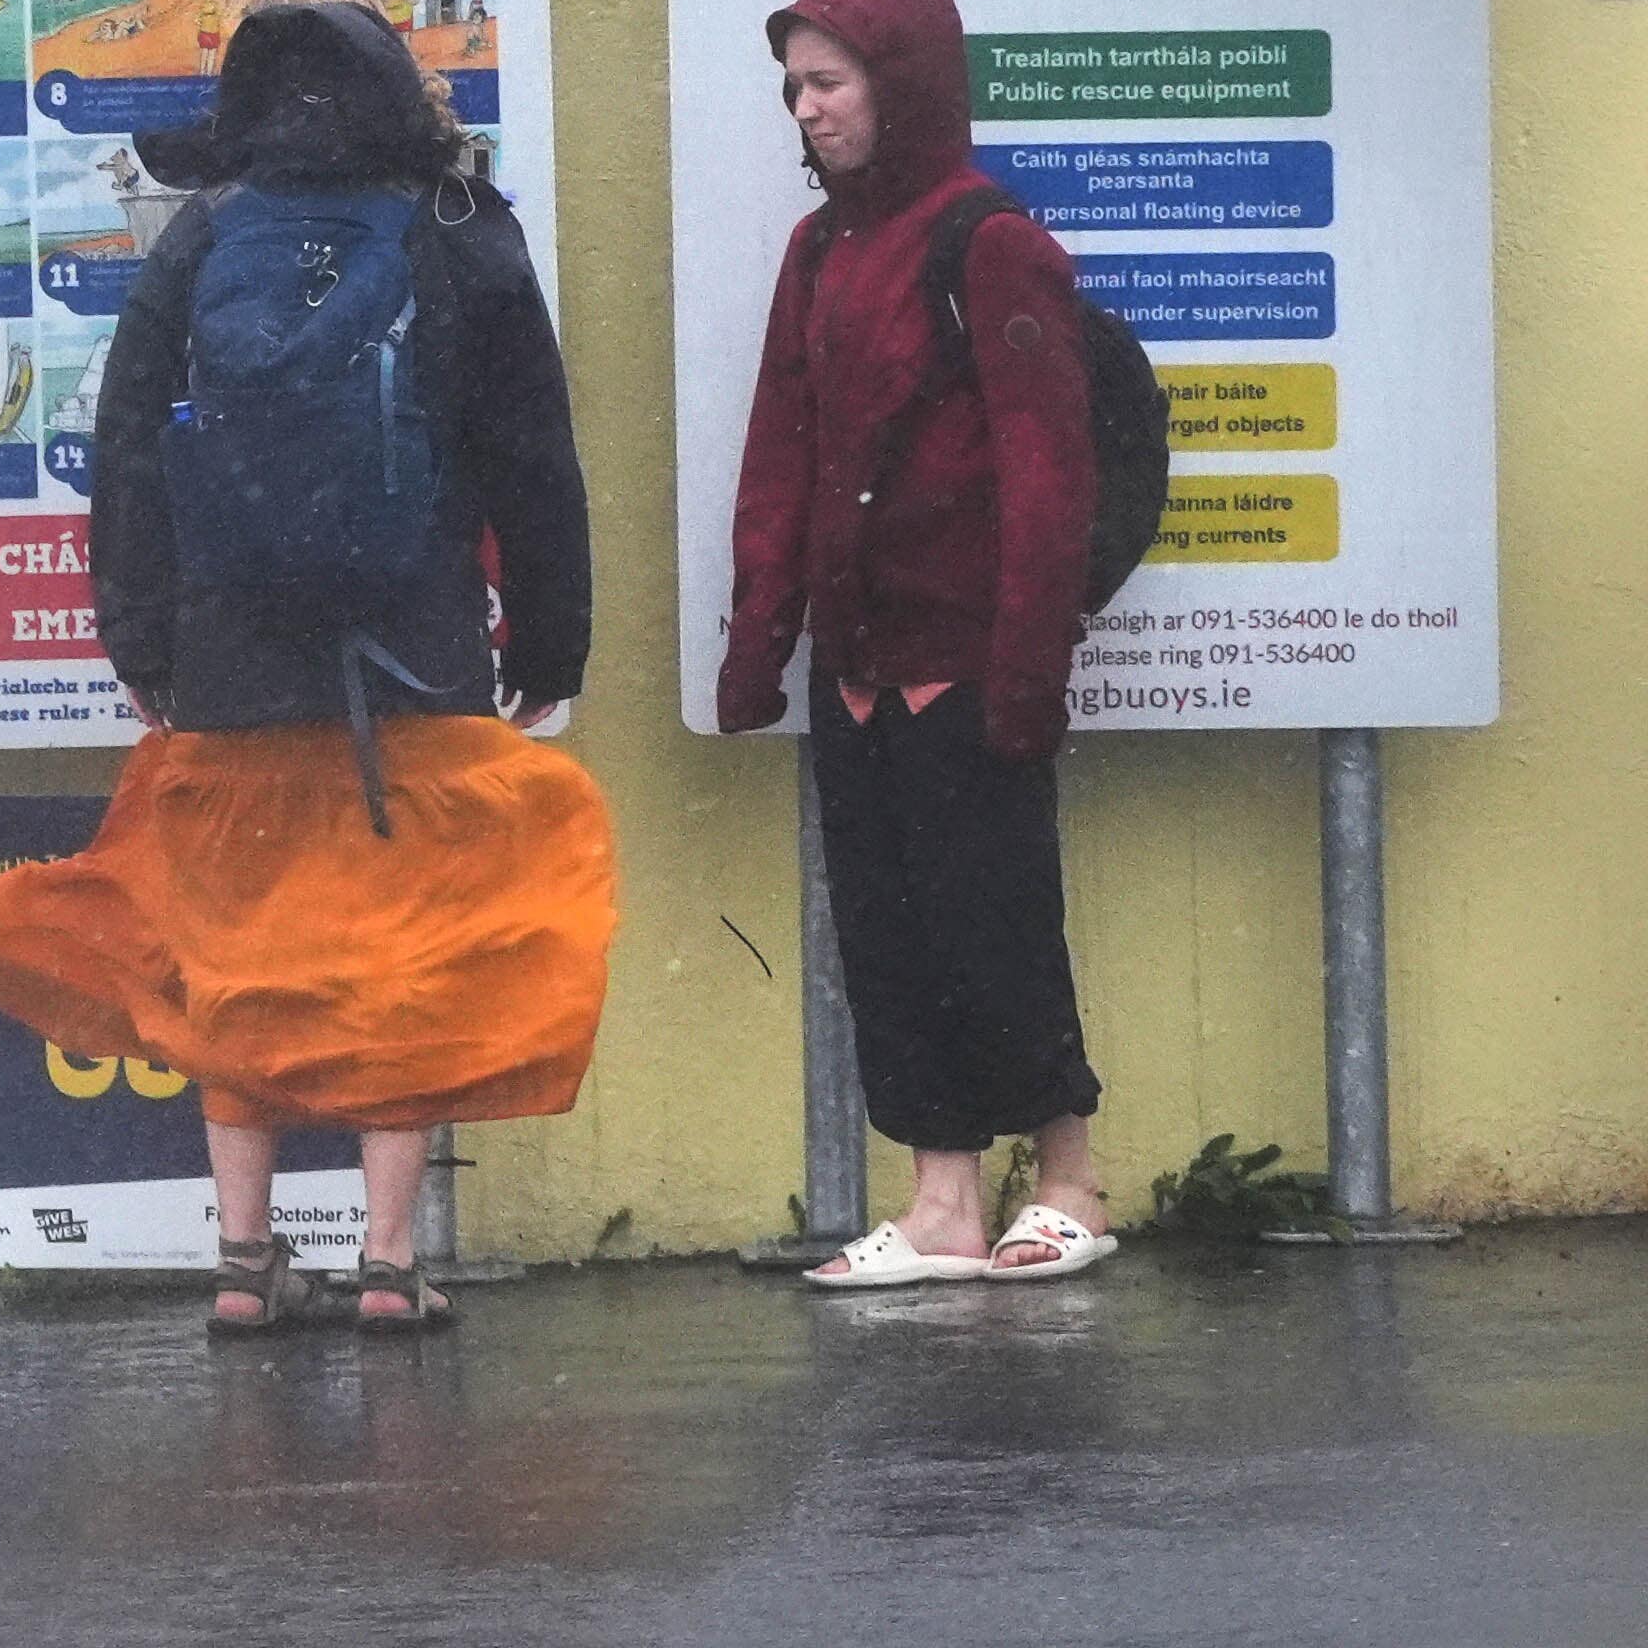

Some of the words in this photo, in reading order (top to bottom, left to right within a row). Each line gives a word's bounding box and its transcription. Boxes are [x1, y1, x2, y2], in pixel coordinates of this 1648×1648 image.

[991, 48, 1102, 67] Trealamh
[1109, 47, 1211, 66] tarrthála
[51, 83, 67, 105] 8
[989, 82, 1064, 101] Public
[1072, 85, 1154, 100] rescue
[1161, 80, 1290, 102] equipment
[1012, 151, 1067, 167] Caith
[1074, 150, 1131, 171] gléas
[1138, 150, 1269, 166] snámhachta
[1088, 174, 1193, 192] pearsanta
[1044, 203, 1137, 223] personal
[1144, 203, 1224, 223] floating
[1232, 202, 1301, 218] device
[50, 264, 79, 287] 11
[1132, 271, 1172, 287] faoi
[1180, 270, 1326, 286] mhaoirseacht
[1123, 304, 1186, 323] under
[1192, 303, 1318, 322] supervision
[1216, 384, 1267, 399] báite
[1227, 415, 1305, 436] objects
[54, 446, 85, 468] 14
[1234, 494, 1293, 511] láidre
[1197, 527, 1287, 545] currents
[1164, 616, 1185, 630] ar
[1192, 609, 1336, 629] 091-536400
[1345, 610, 1363, 628] le
[1372, 609, 1399, 627] do
[1408, 608, 1456, 627] thoil
[1081, 645, 1152, 669] please
[1160, 645, 1202, 669] ring
[1210, 644, 1355, 664] 091-536400
[87, 680, 118, 693] seo
[1065, 678, 1251, 714] ngbuoys.ie
[39, 704, 90, 720] rules
[34, 1210, 70, 1228] GIVE
[270, 1206, 343, 1222] October
[349, 1206, 366, 1222] 3r
[47, 1222, 89, 1241] WEST
